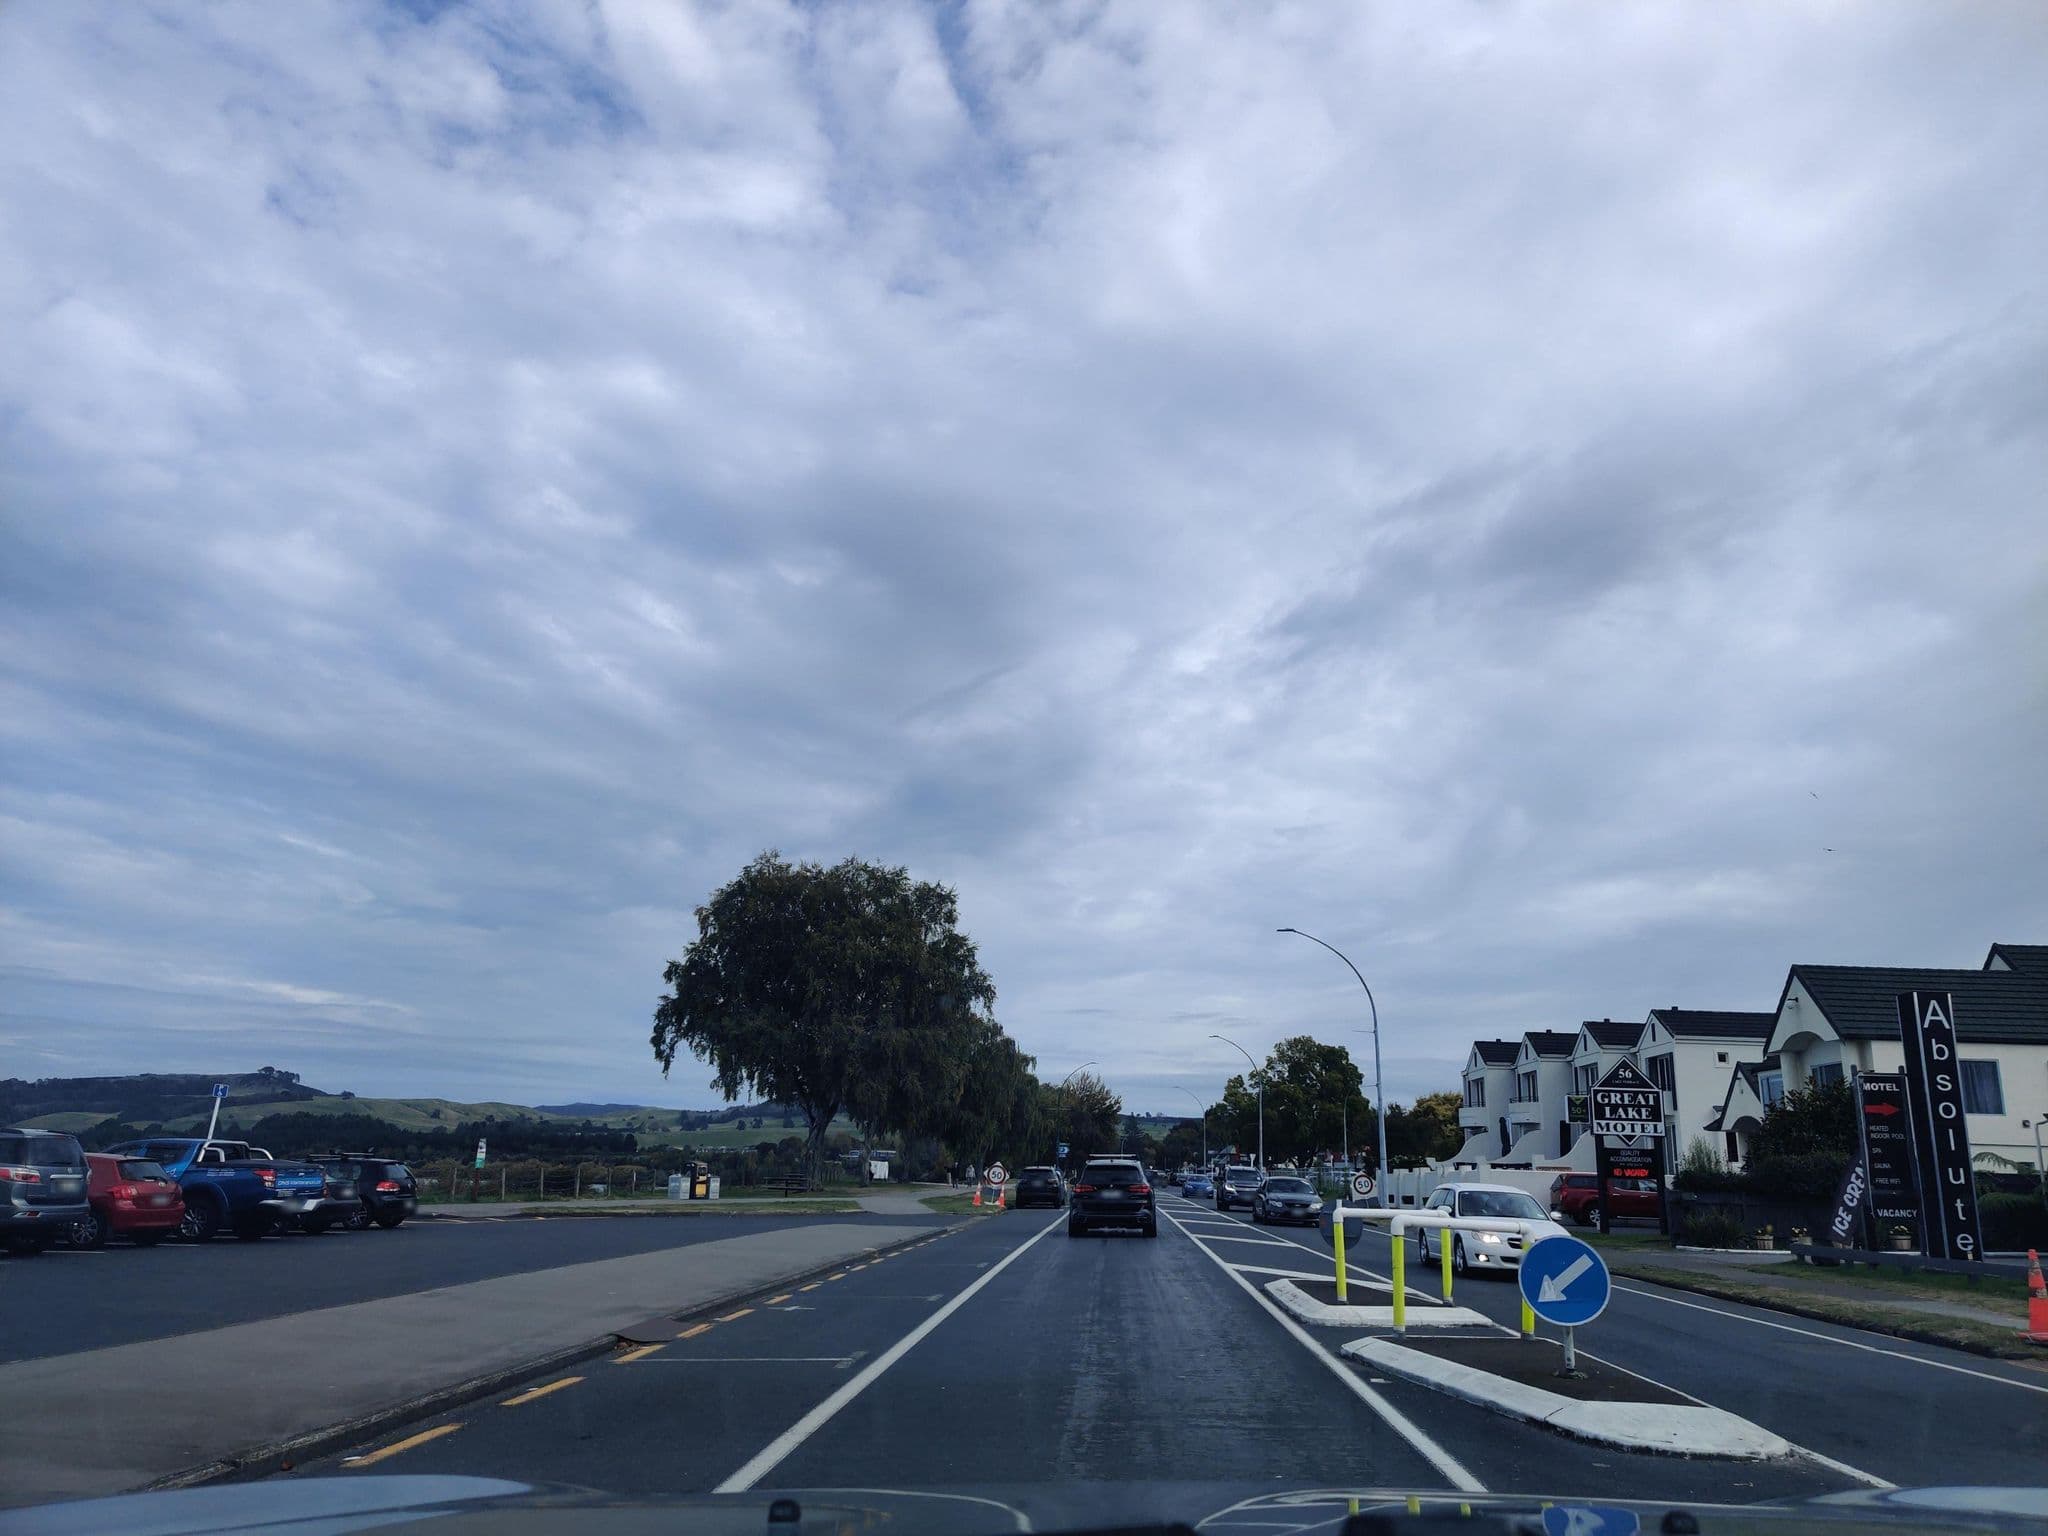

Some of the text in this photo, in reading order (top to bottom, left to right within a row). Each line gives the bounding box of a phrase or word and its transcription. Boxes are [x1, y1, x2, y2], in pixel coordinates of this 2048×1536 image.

[1618, 1068, 1632, 1078] 56
[1862, 1083, 1899, 1091] MOTEL
[1596, 1092, 1657, 1106] GREAT
[1604, 1107, 1652, 1119] LAKE
[1596, 1123, 1662, 1133] MOTEL
[1923, 999, 1974, 1251] Absolute
[992, 1171, 1002, 1179] 50
[1358, 1180, 1369, 1189] 50
[1877, 1209, 1918, 1217] VACANCY
[1832, 1206, 1853, 1237] ICE
